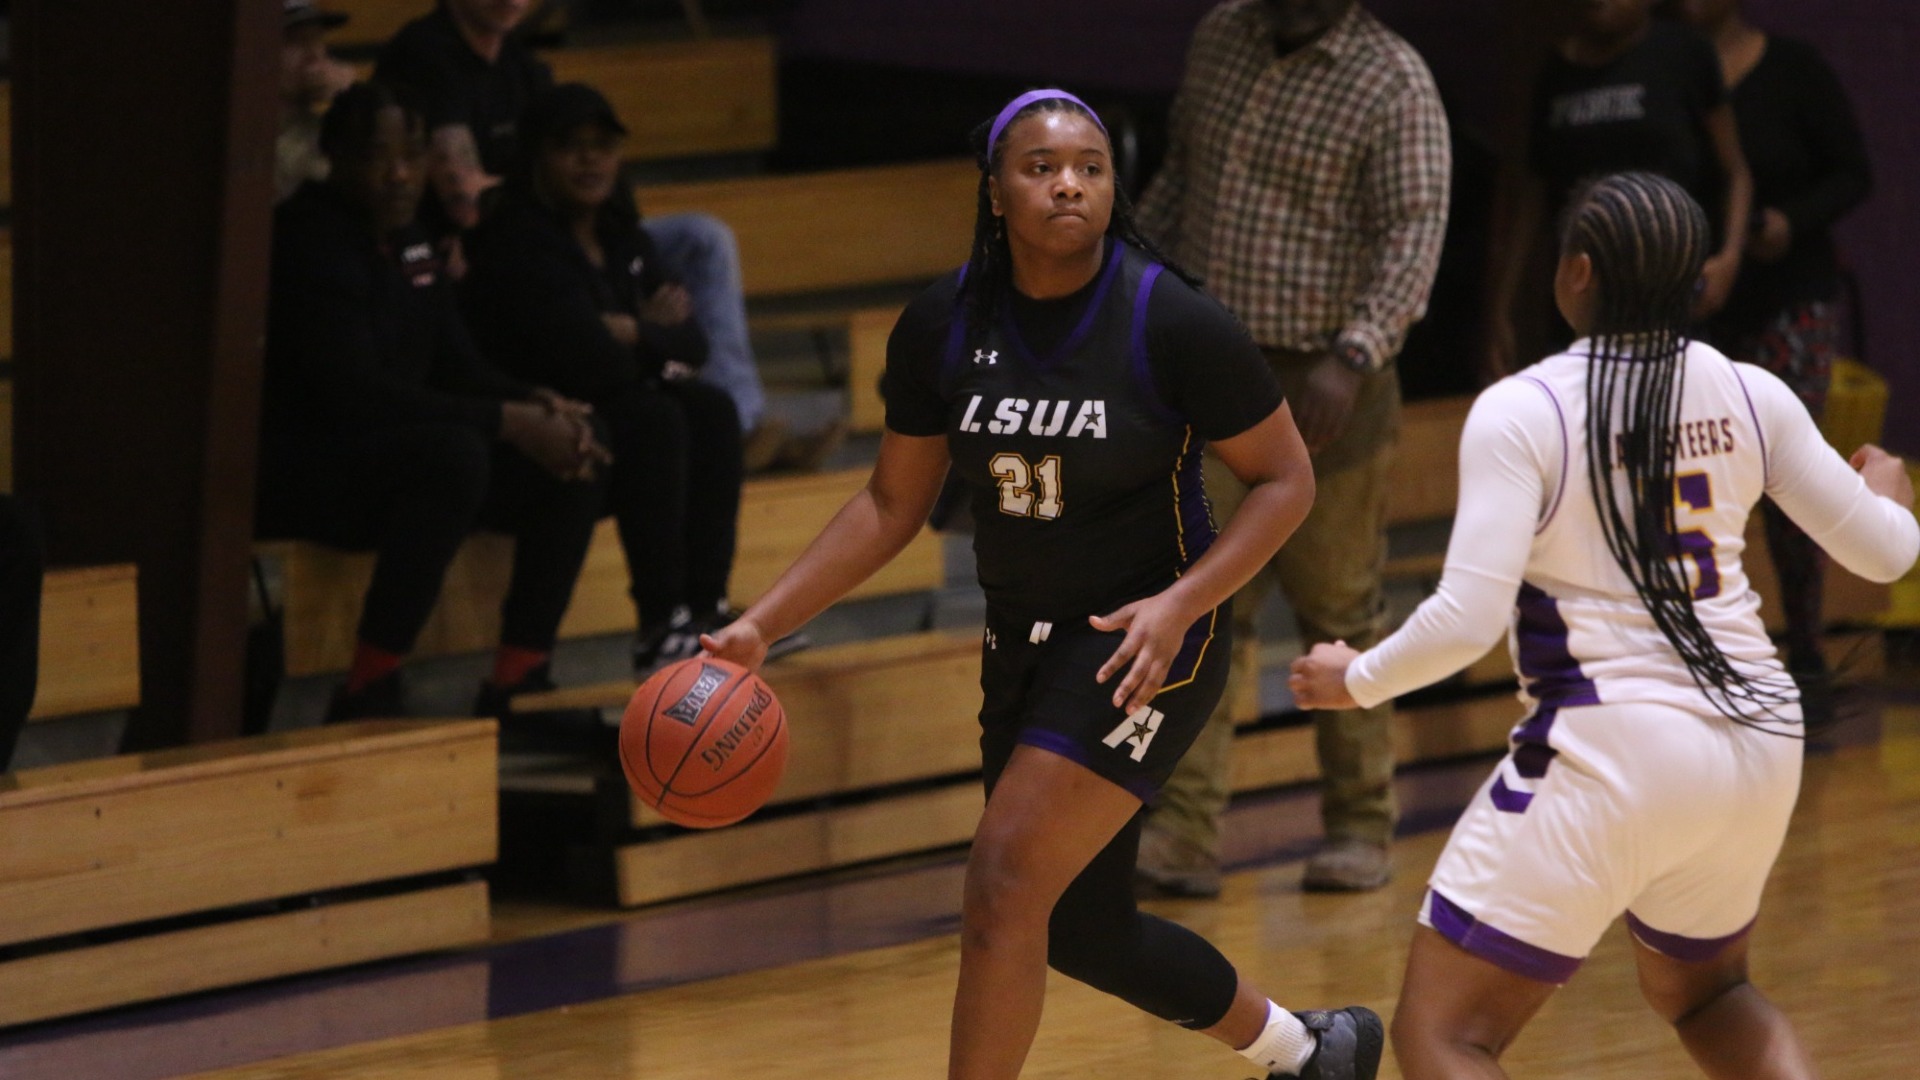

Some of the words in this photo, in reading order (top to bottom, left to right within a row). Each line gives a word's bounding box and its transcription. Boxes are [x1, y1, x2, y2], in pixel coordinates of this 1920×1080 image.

[959, 395, 1107, 438] LSUA
[989, 452, 1064, 521] 21
[701, 681, 772, 772] SPALDING
